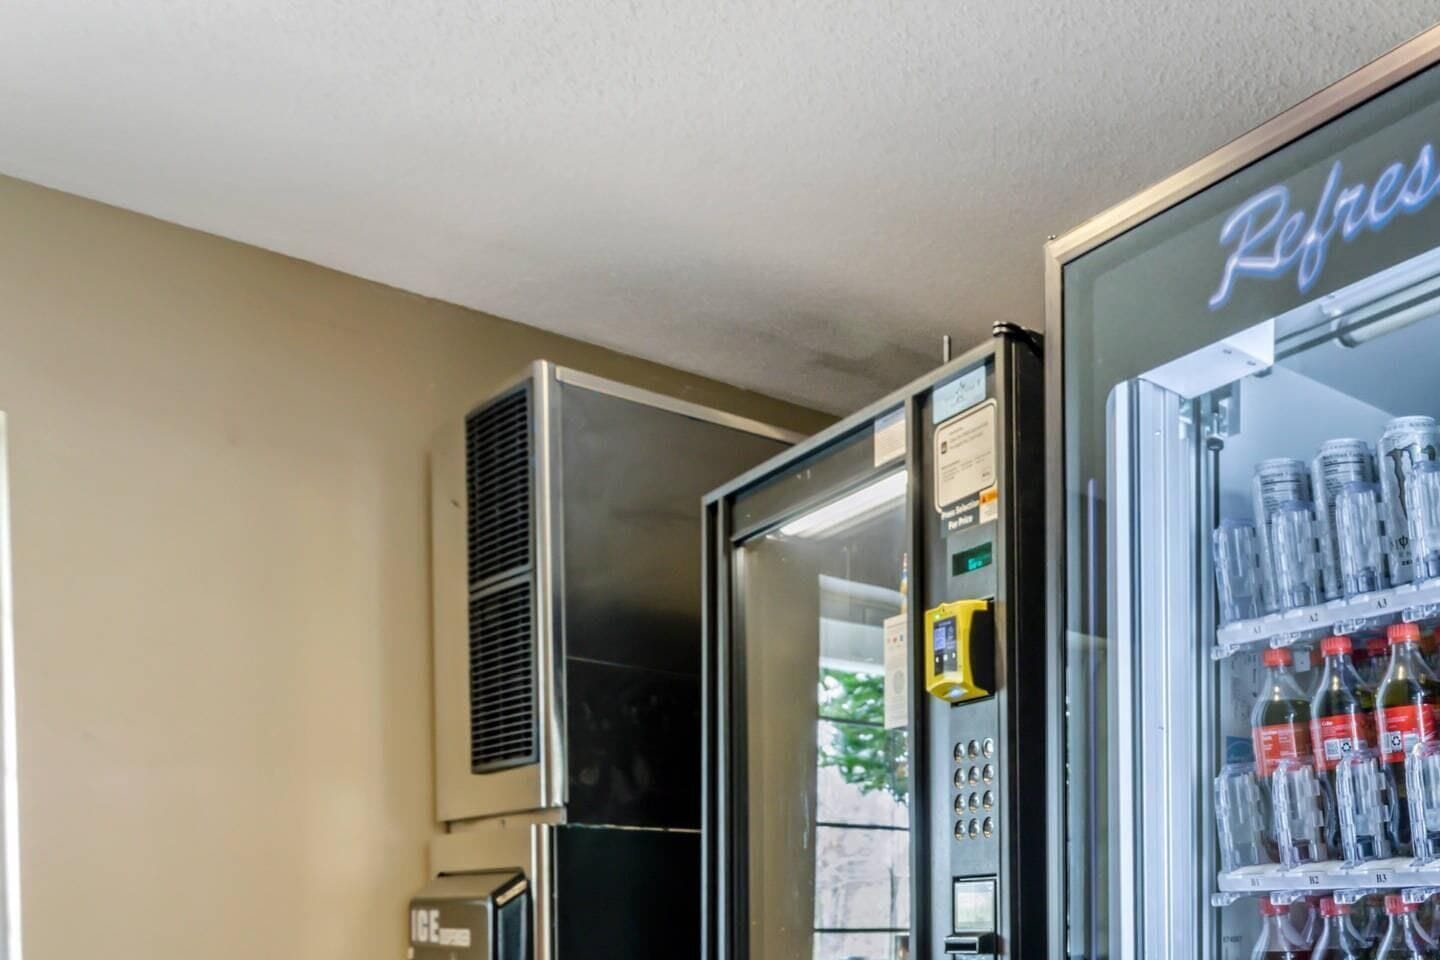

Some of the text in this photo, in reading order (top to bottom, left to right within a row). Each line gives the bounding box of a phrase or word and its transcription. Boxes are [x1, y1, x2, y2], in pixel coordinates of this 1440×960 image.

[1377, 598, 1388, 609] A3
[1309, 613, 1319, 623] A2
[1309, 875, 1319, 884] B2
[1376, 873, 1387, 883] B3
[411, 909, 440, 943] ICE
